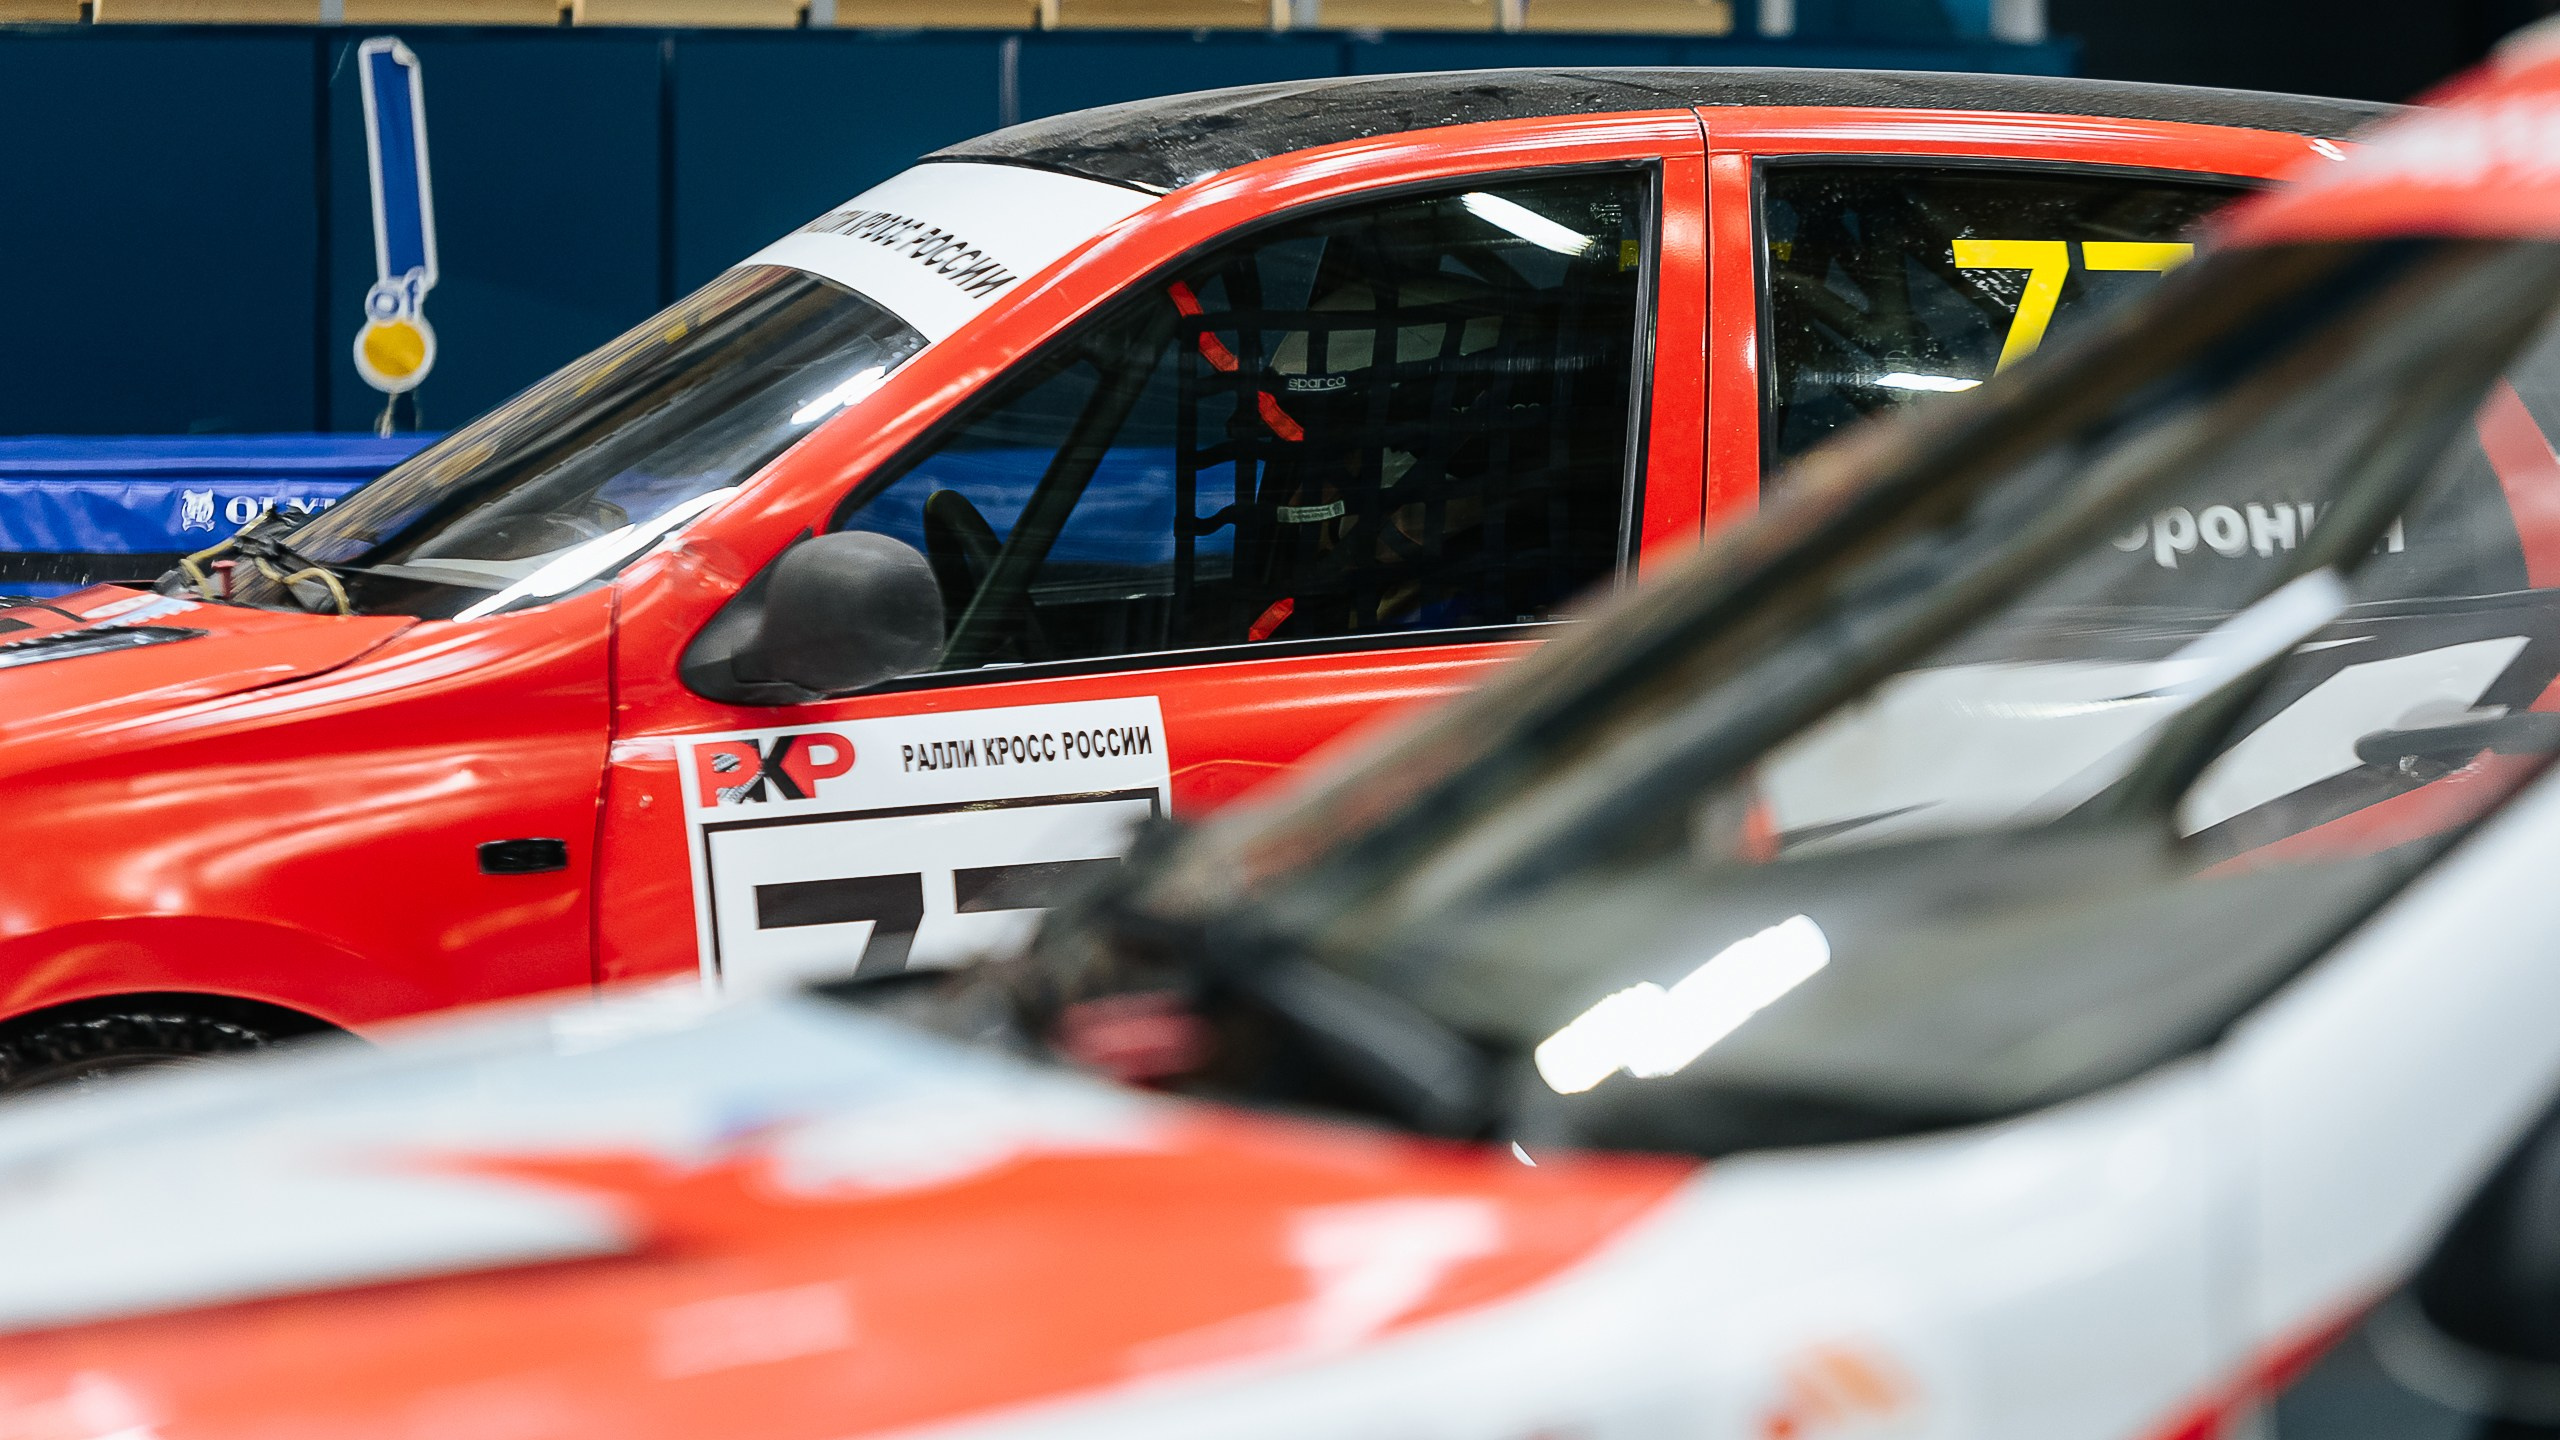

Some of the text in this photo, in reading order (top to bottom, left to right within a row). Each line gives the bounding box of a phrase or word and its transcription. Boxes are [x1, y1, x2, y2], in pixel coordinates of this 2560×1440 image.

[894, 227, 1017, 299] РОССИИ
[1288, 377, 1346, 391] sparco
[900, 725, 1152, 772] РАЛЛИ КРОСС РОССИИ
